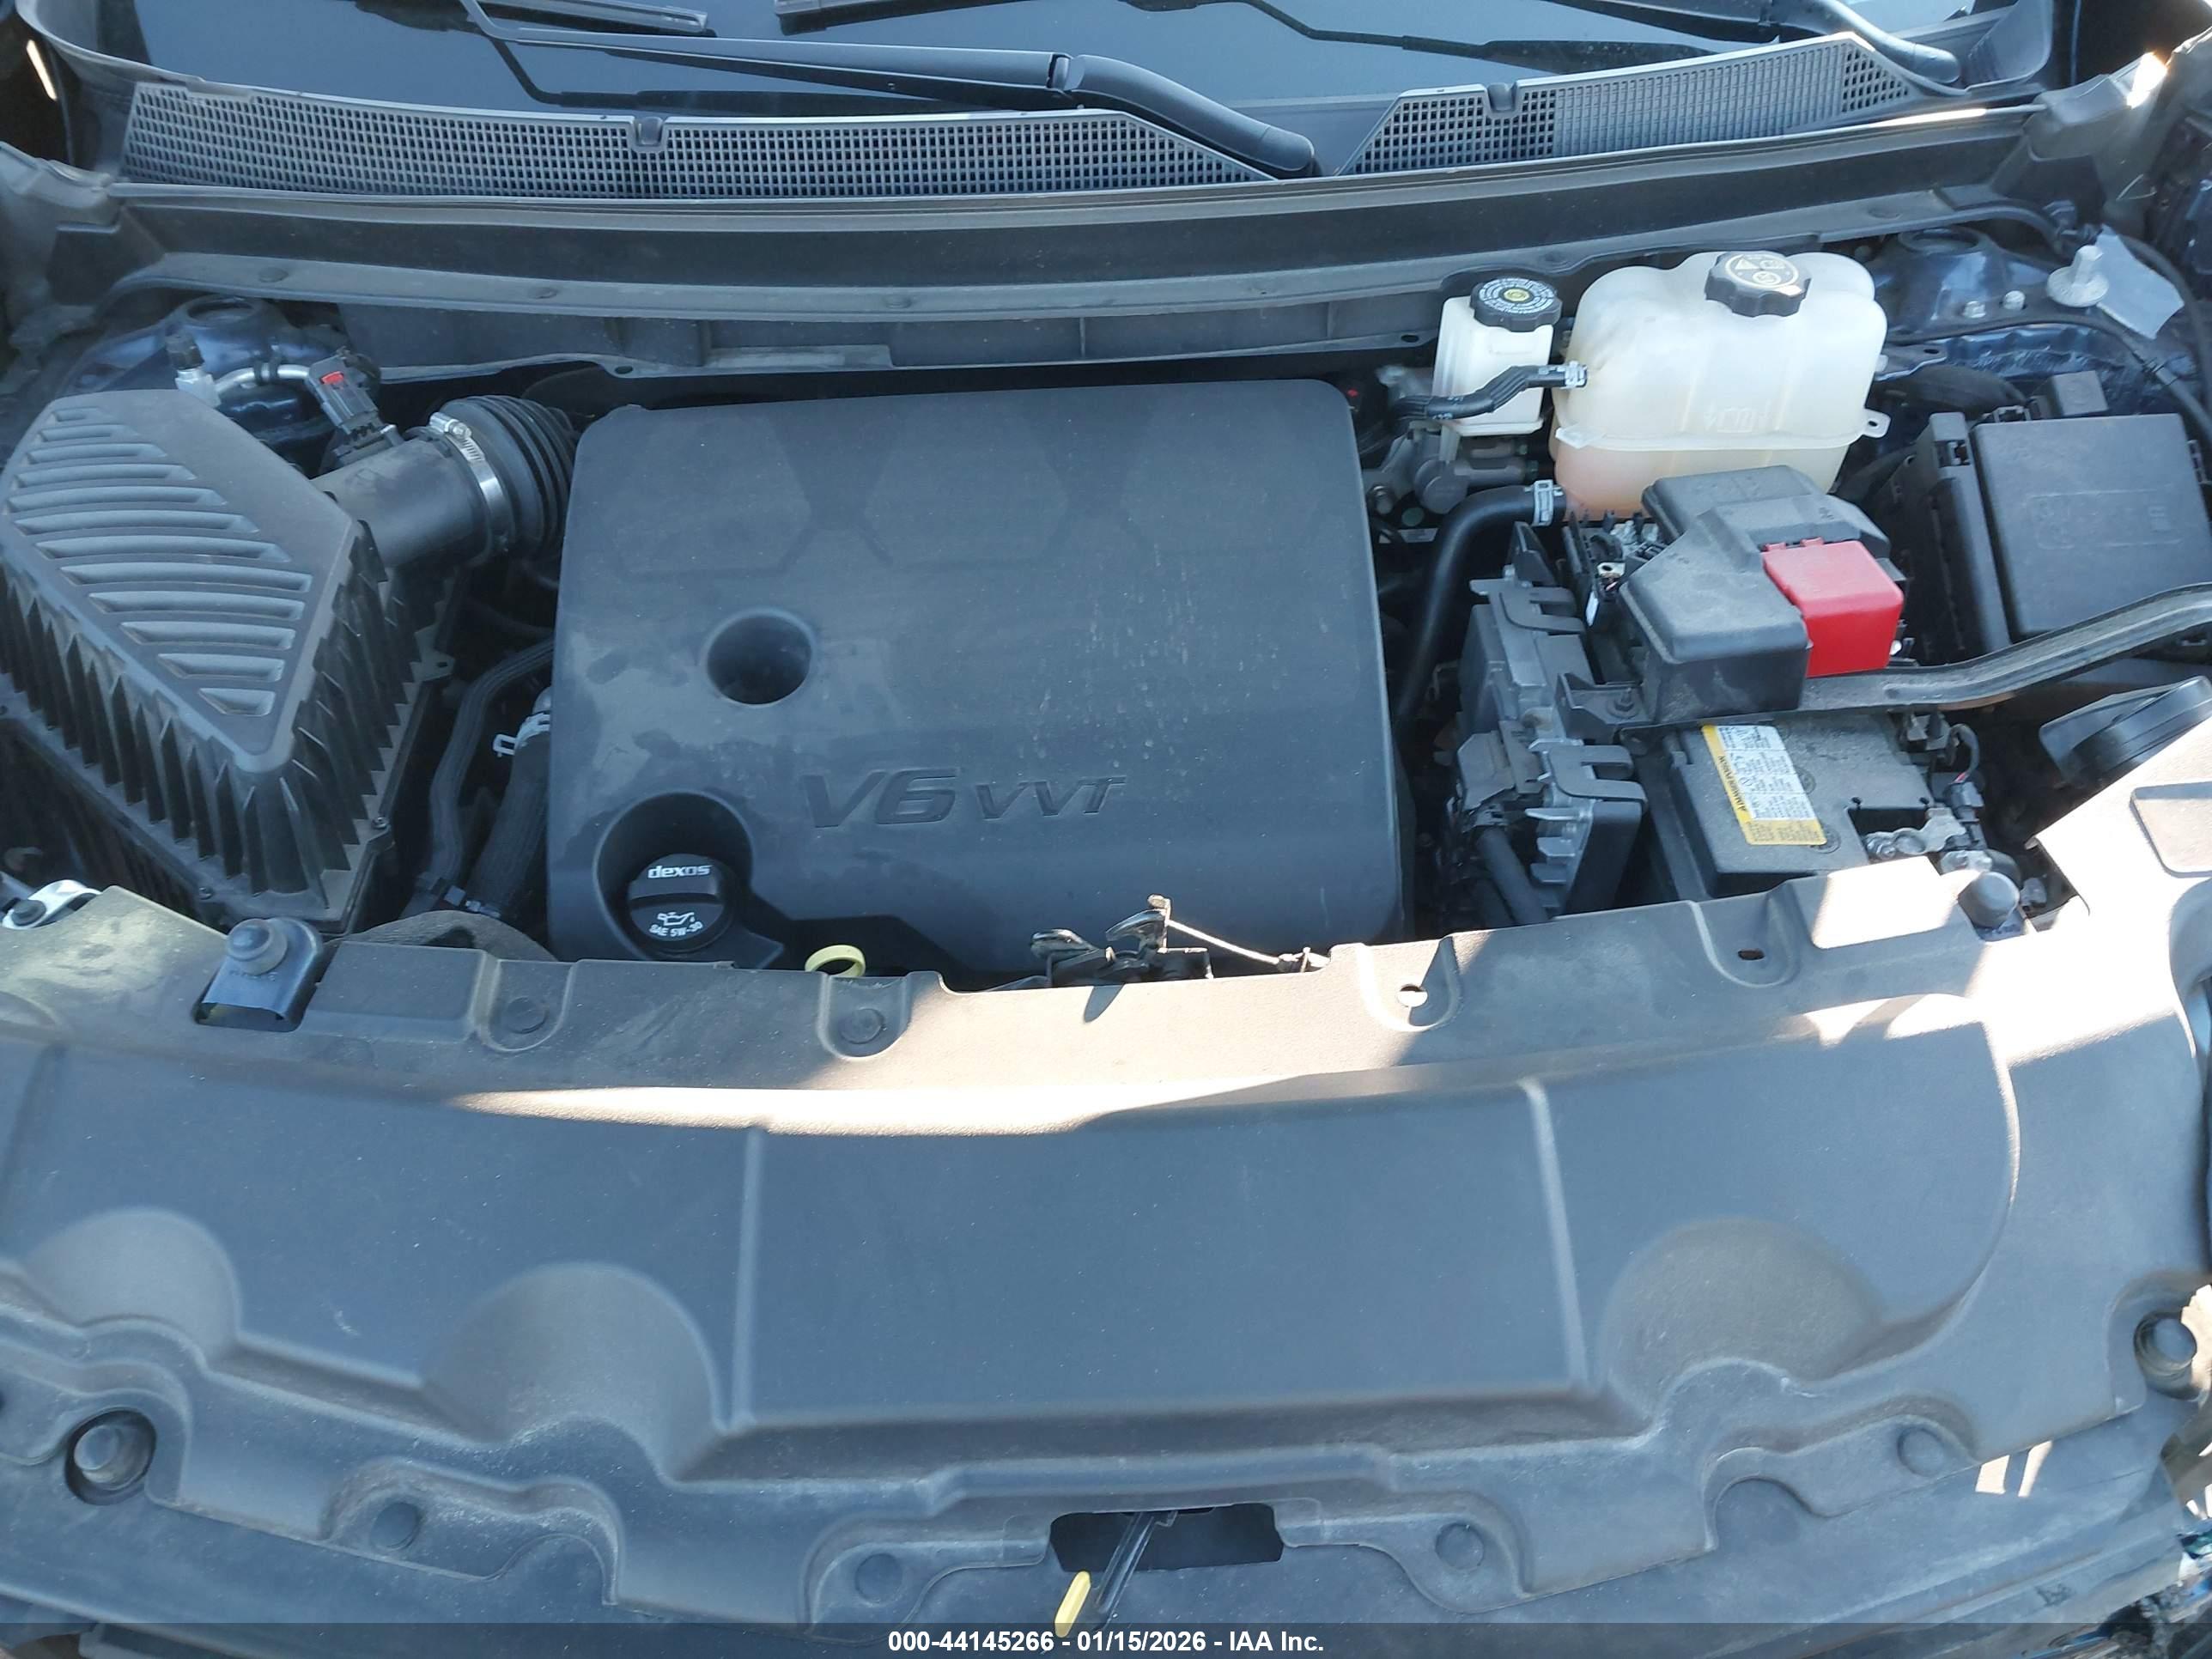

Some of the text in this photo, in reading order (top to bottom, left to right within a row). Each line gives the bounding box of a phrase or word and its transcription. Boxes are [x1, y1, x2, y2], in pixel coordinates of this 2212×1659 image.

[801, 769, 1126, 828] V6 VVT
[647, 865, 712, 878] dexos
[649, 924, 669, 936] SAE
